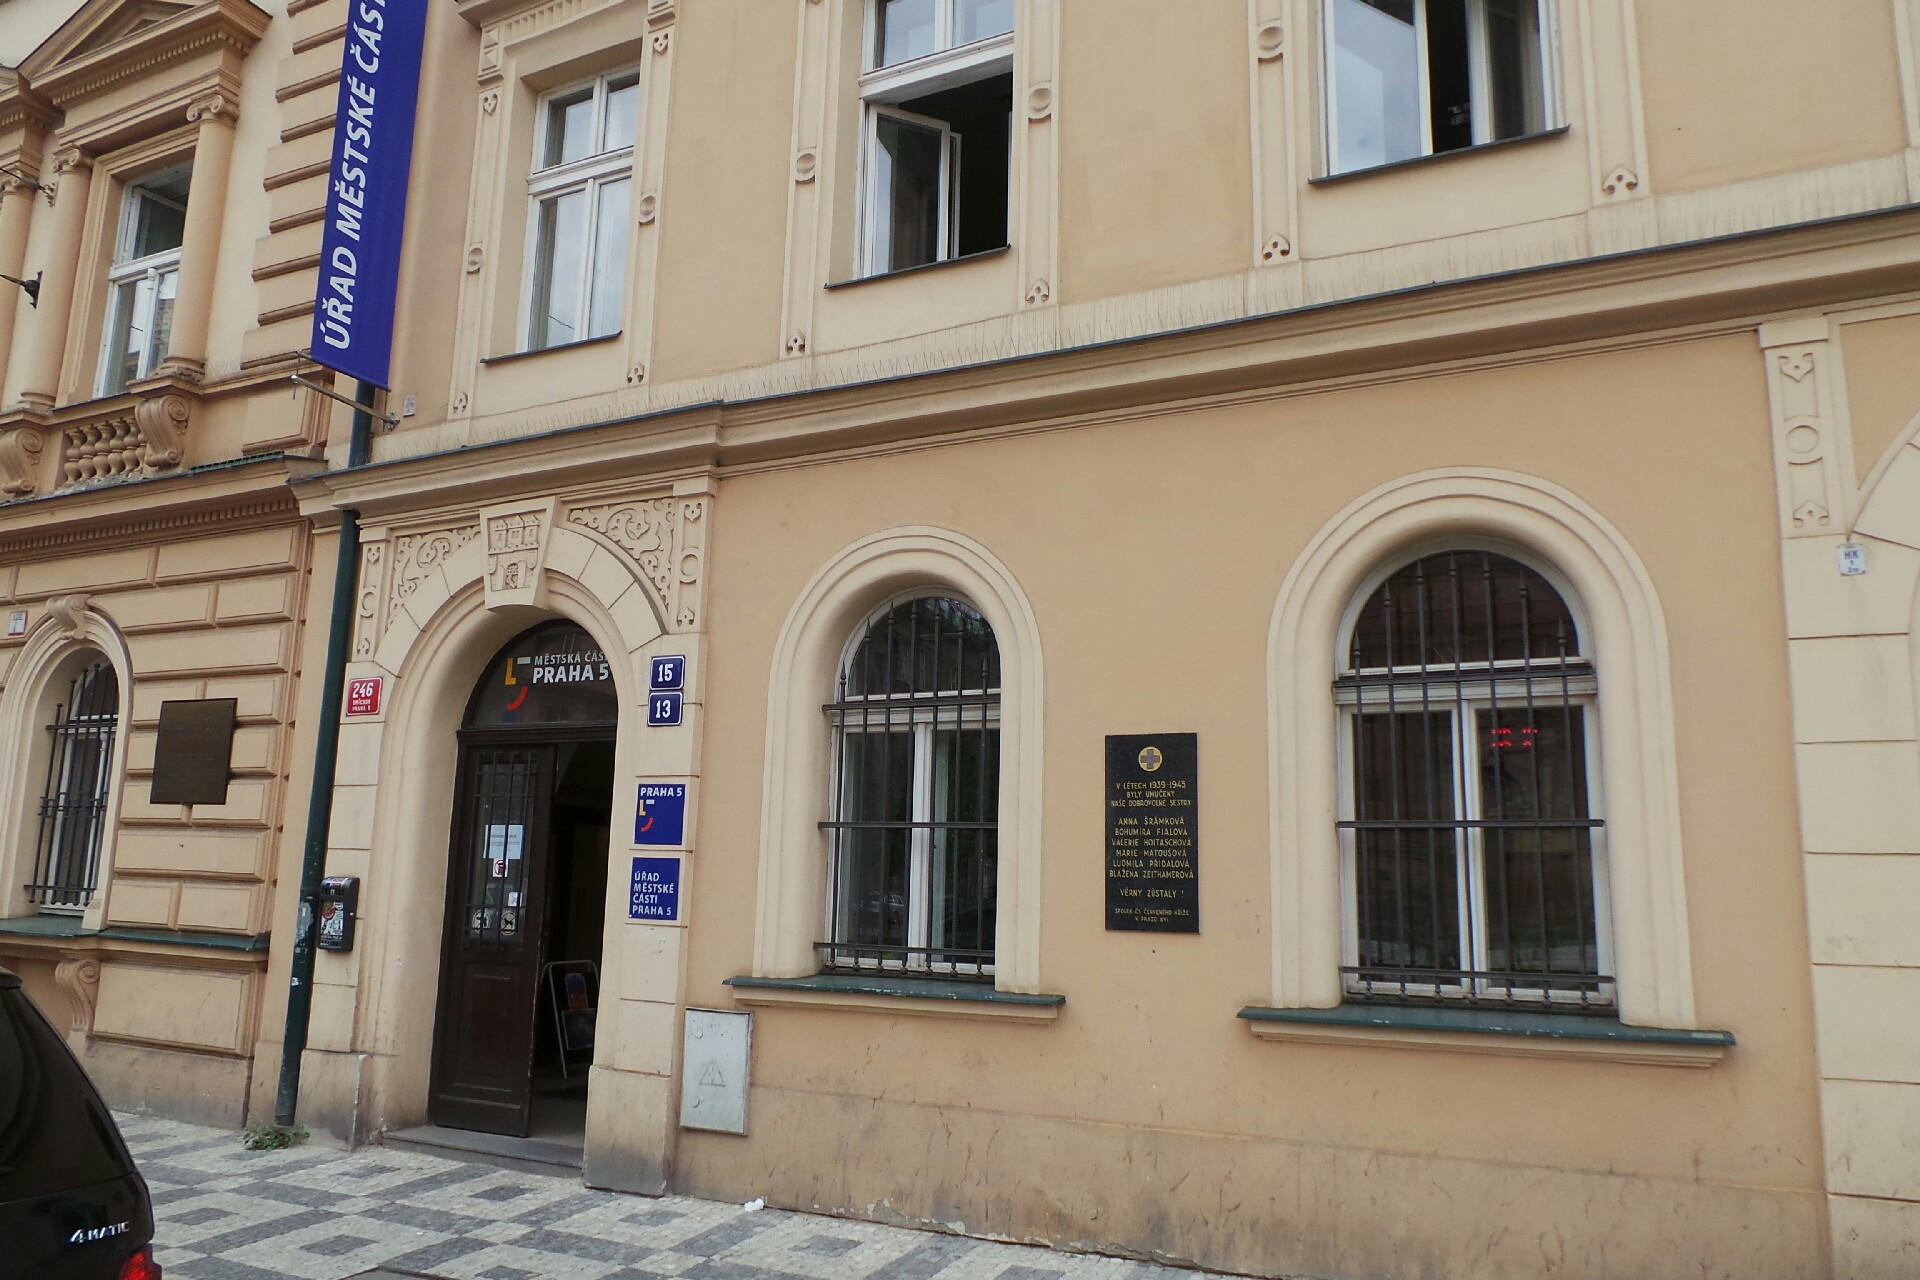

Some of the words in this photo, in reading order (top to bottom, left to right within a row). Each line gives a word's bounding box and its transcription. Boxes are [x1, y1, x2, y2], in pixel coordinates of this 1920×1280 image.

[335, 77, 375, 242] MĚSTSKÉ
[320, 245, 357, 350] ÚŘAD
[534, 651, 581, 666] MĚSTSKÁ
[585, 650, 608, 662] ČÁS
[532, 664, 594, 684] PRAHA
[599, 663, 609, 680] 5
[658, 663, 673, 682] 15
[353, 683, 373, 698] 246
[656, 699, 671, 719] 13
[1116, 782, 1121, 790] V
[640, 787, 674, 797] PRAHA
[677, 787, 682, 797] 5
[1145, 789, 1175, 797] UMUČENY
[1111, 799, 1126, 807] NAŠE
[1118, 817, 1138, 825] ANNA
[1144, 815, 1185, 825] ŠRÁMKOVÁ
[1111, 838, 1140, 846] VALERIE
[1116, 849, 1138, 857] MARIE
[1144, 848, 1187, 857] MATOUŠOVÁ
[1113, 859, 1144, 867] LUDMILA
[634, 871, 660, 882] ÚŘAD
[1109, 868, 1139, 878] BLAŽENA
[633, 882, 674, 894] MĚSTSKÉ
[1120, 887, 1143, 897] VĚRNY
[633, 893, 658, 904] ČÁSTI
[632, 905, 664, 916] PRAHA
[666, 907, 672, 916] 5
[69, 1221, 130, 1243] 4MATIC
